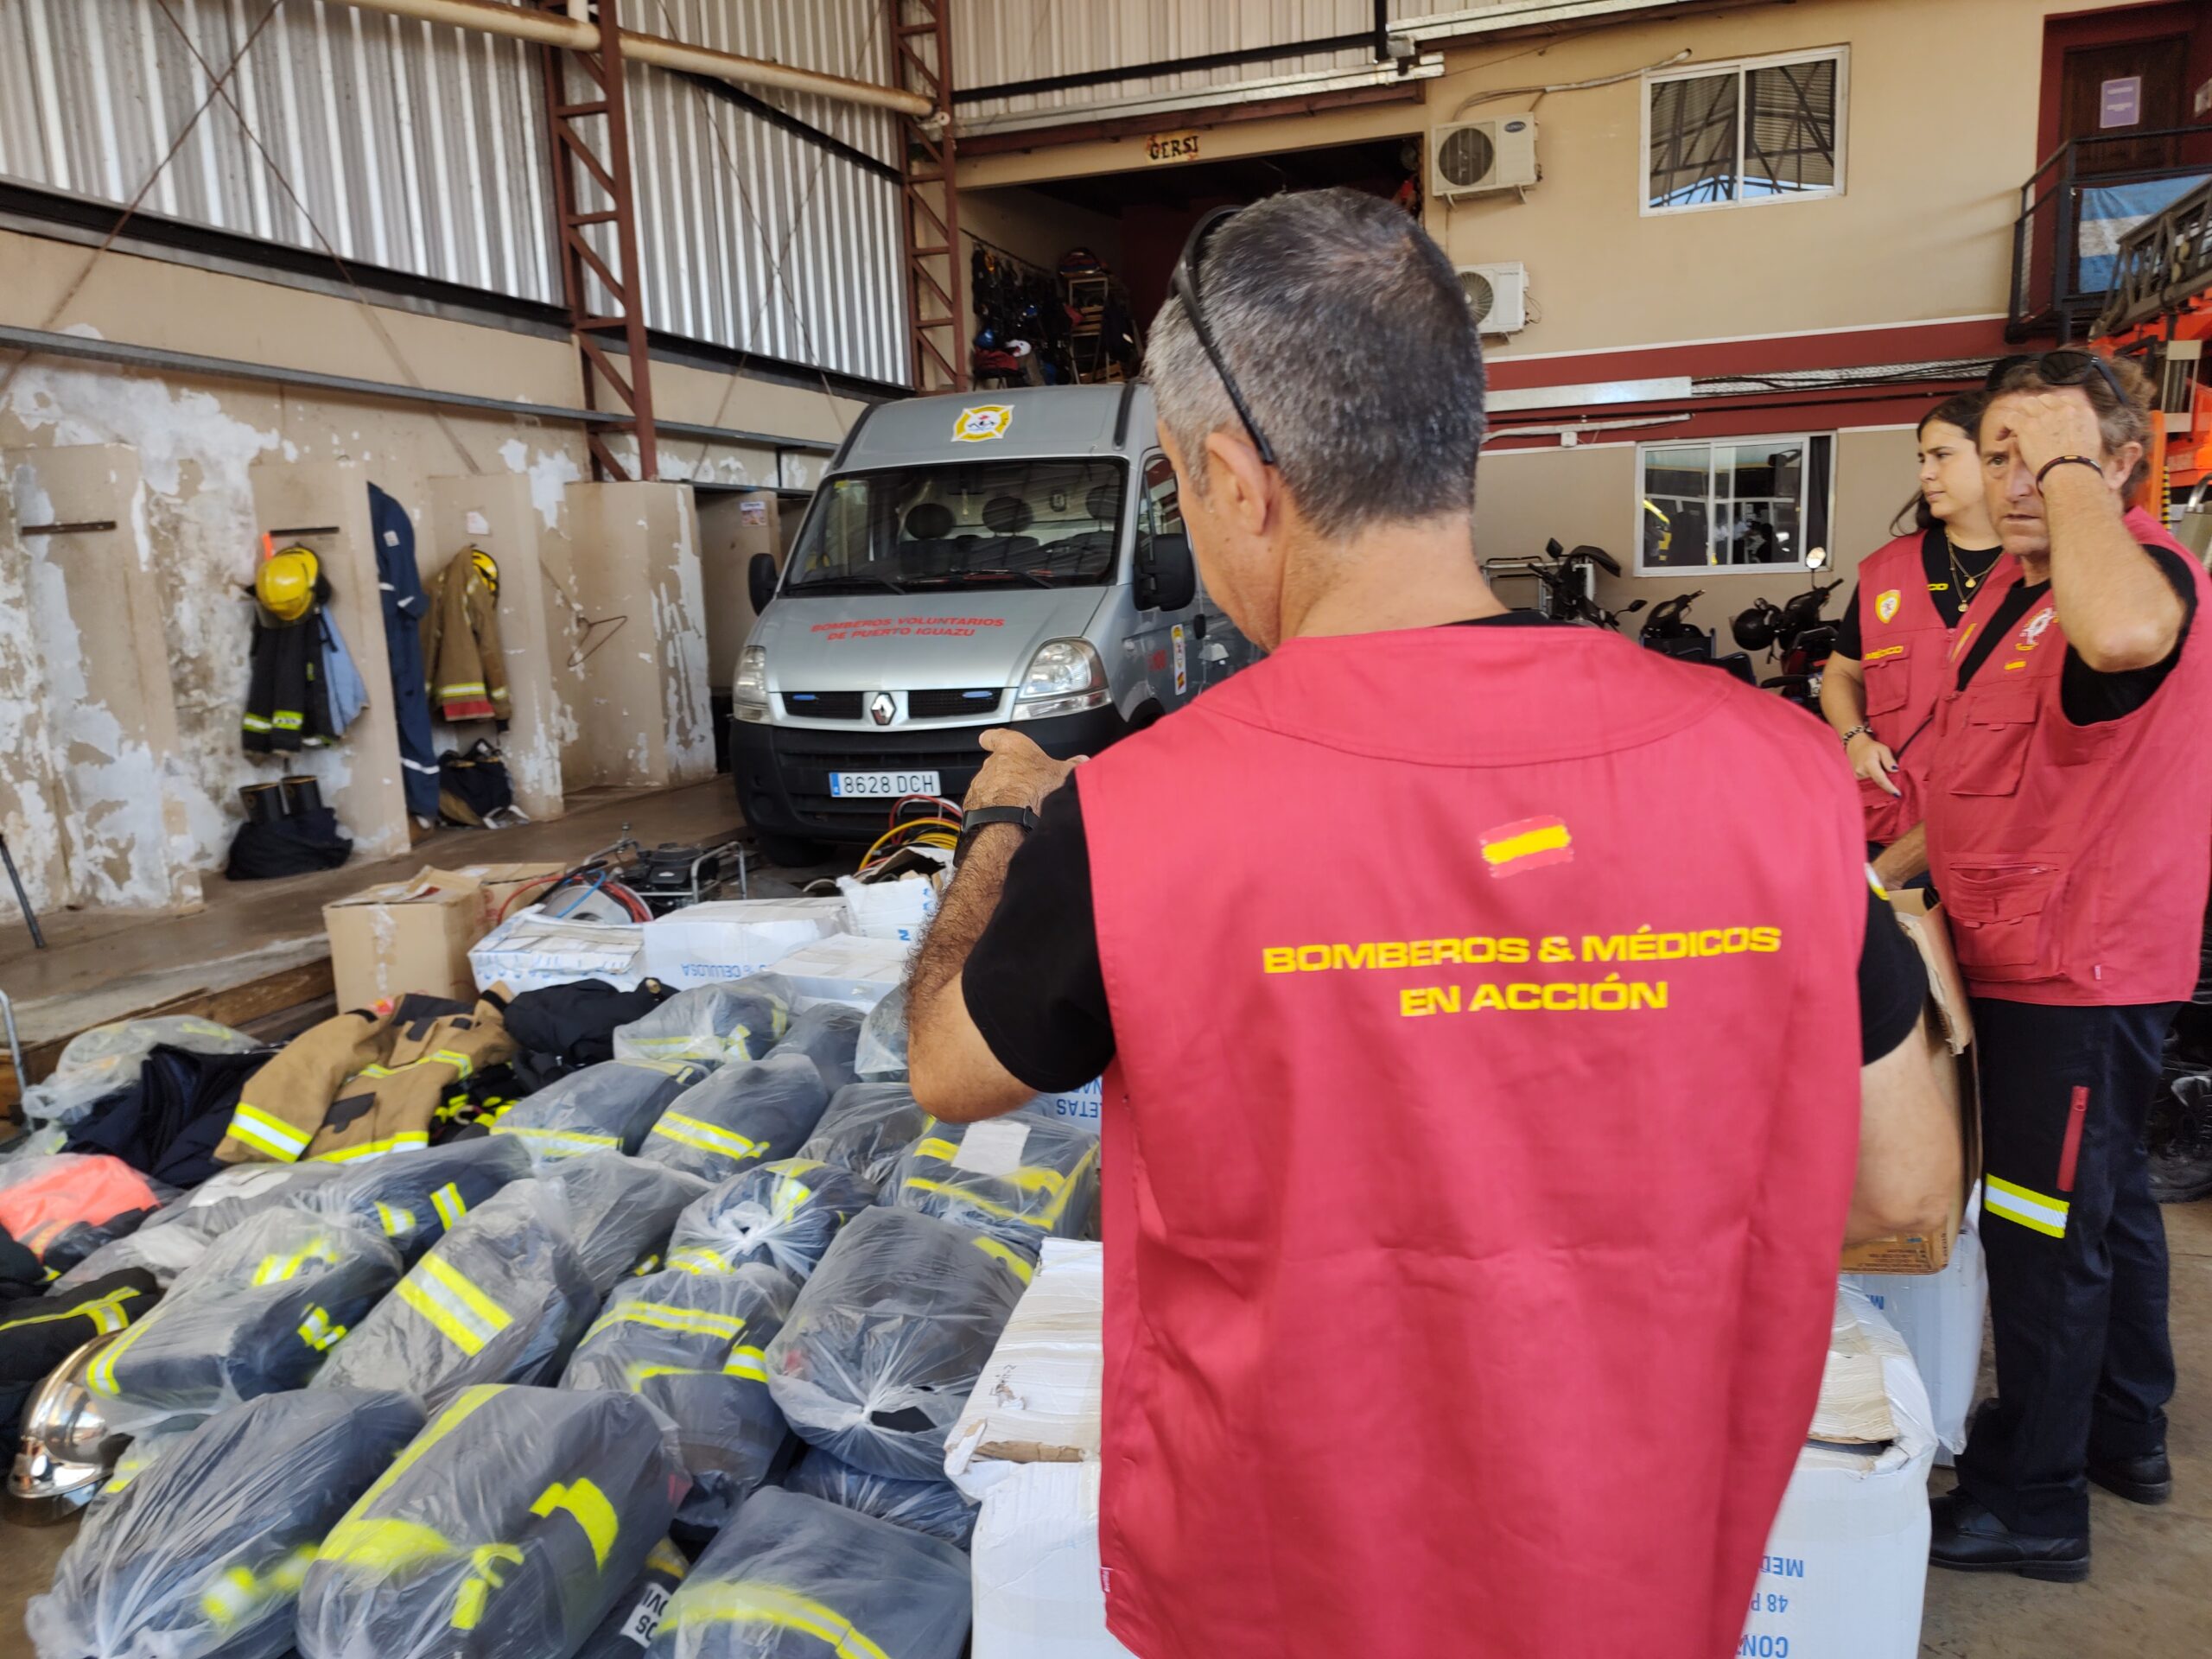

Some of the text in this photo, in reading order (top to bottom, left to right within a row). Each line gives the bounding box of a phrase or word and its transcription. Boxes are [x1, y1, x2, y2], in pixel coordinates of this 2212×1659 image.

[810, 616, 1006, 632] BOMBEROS VOLUNTARIOS
[827, 632, 846, 641] DE
[851, 627, 912, 639] PUERTO
[843, 776, 891, 794] 8628
[897, 774, 935, 793] DCH
[1262, 924, 1783, 974] BOMBEROS & MÉDICOS
[1400, 971, 1669, 1017] EN ACCIÓN
[1056, 1098, 1103, 1118] ETAS
[1767, 1593, 1789, 1613] 48
[1737, 1634, 1789, 1658] CON
